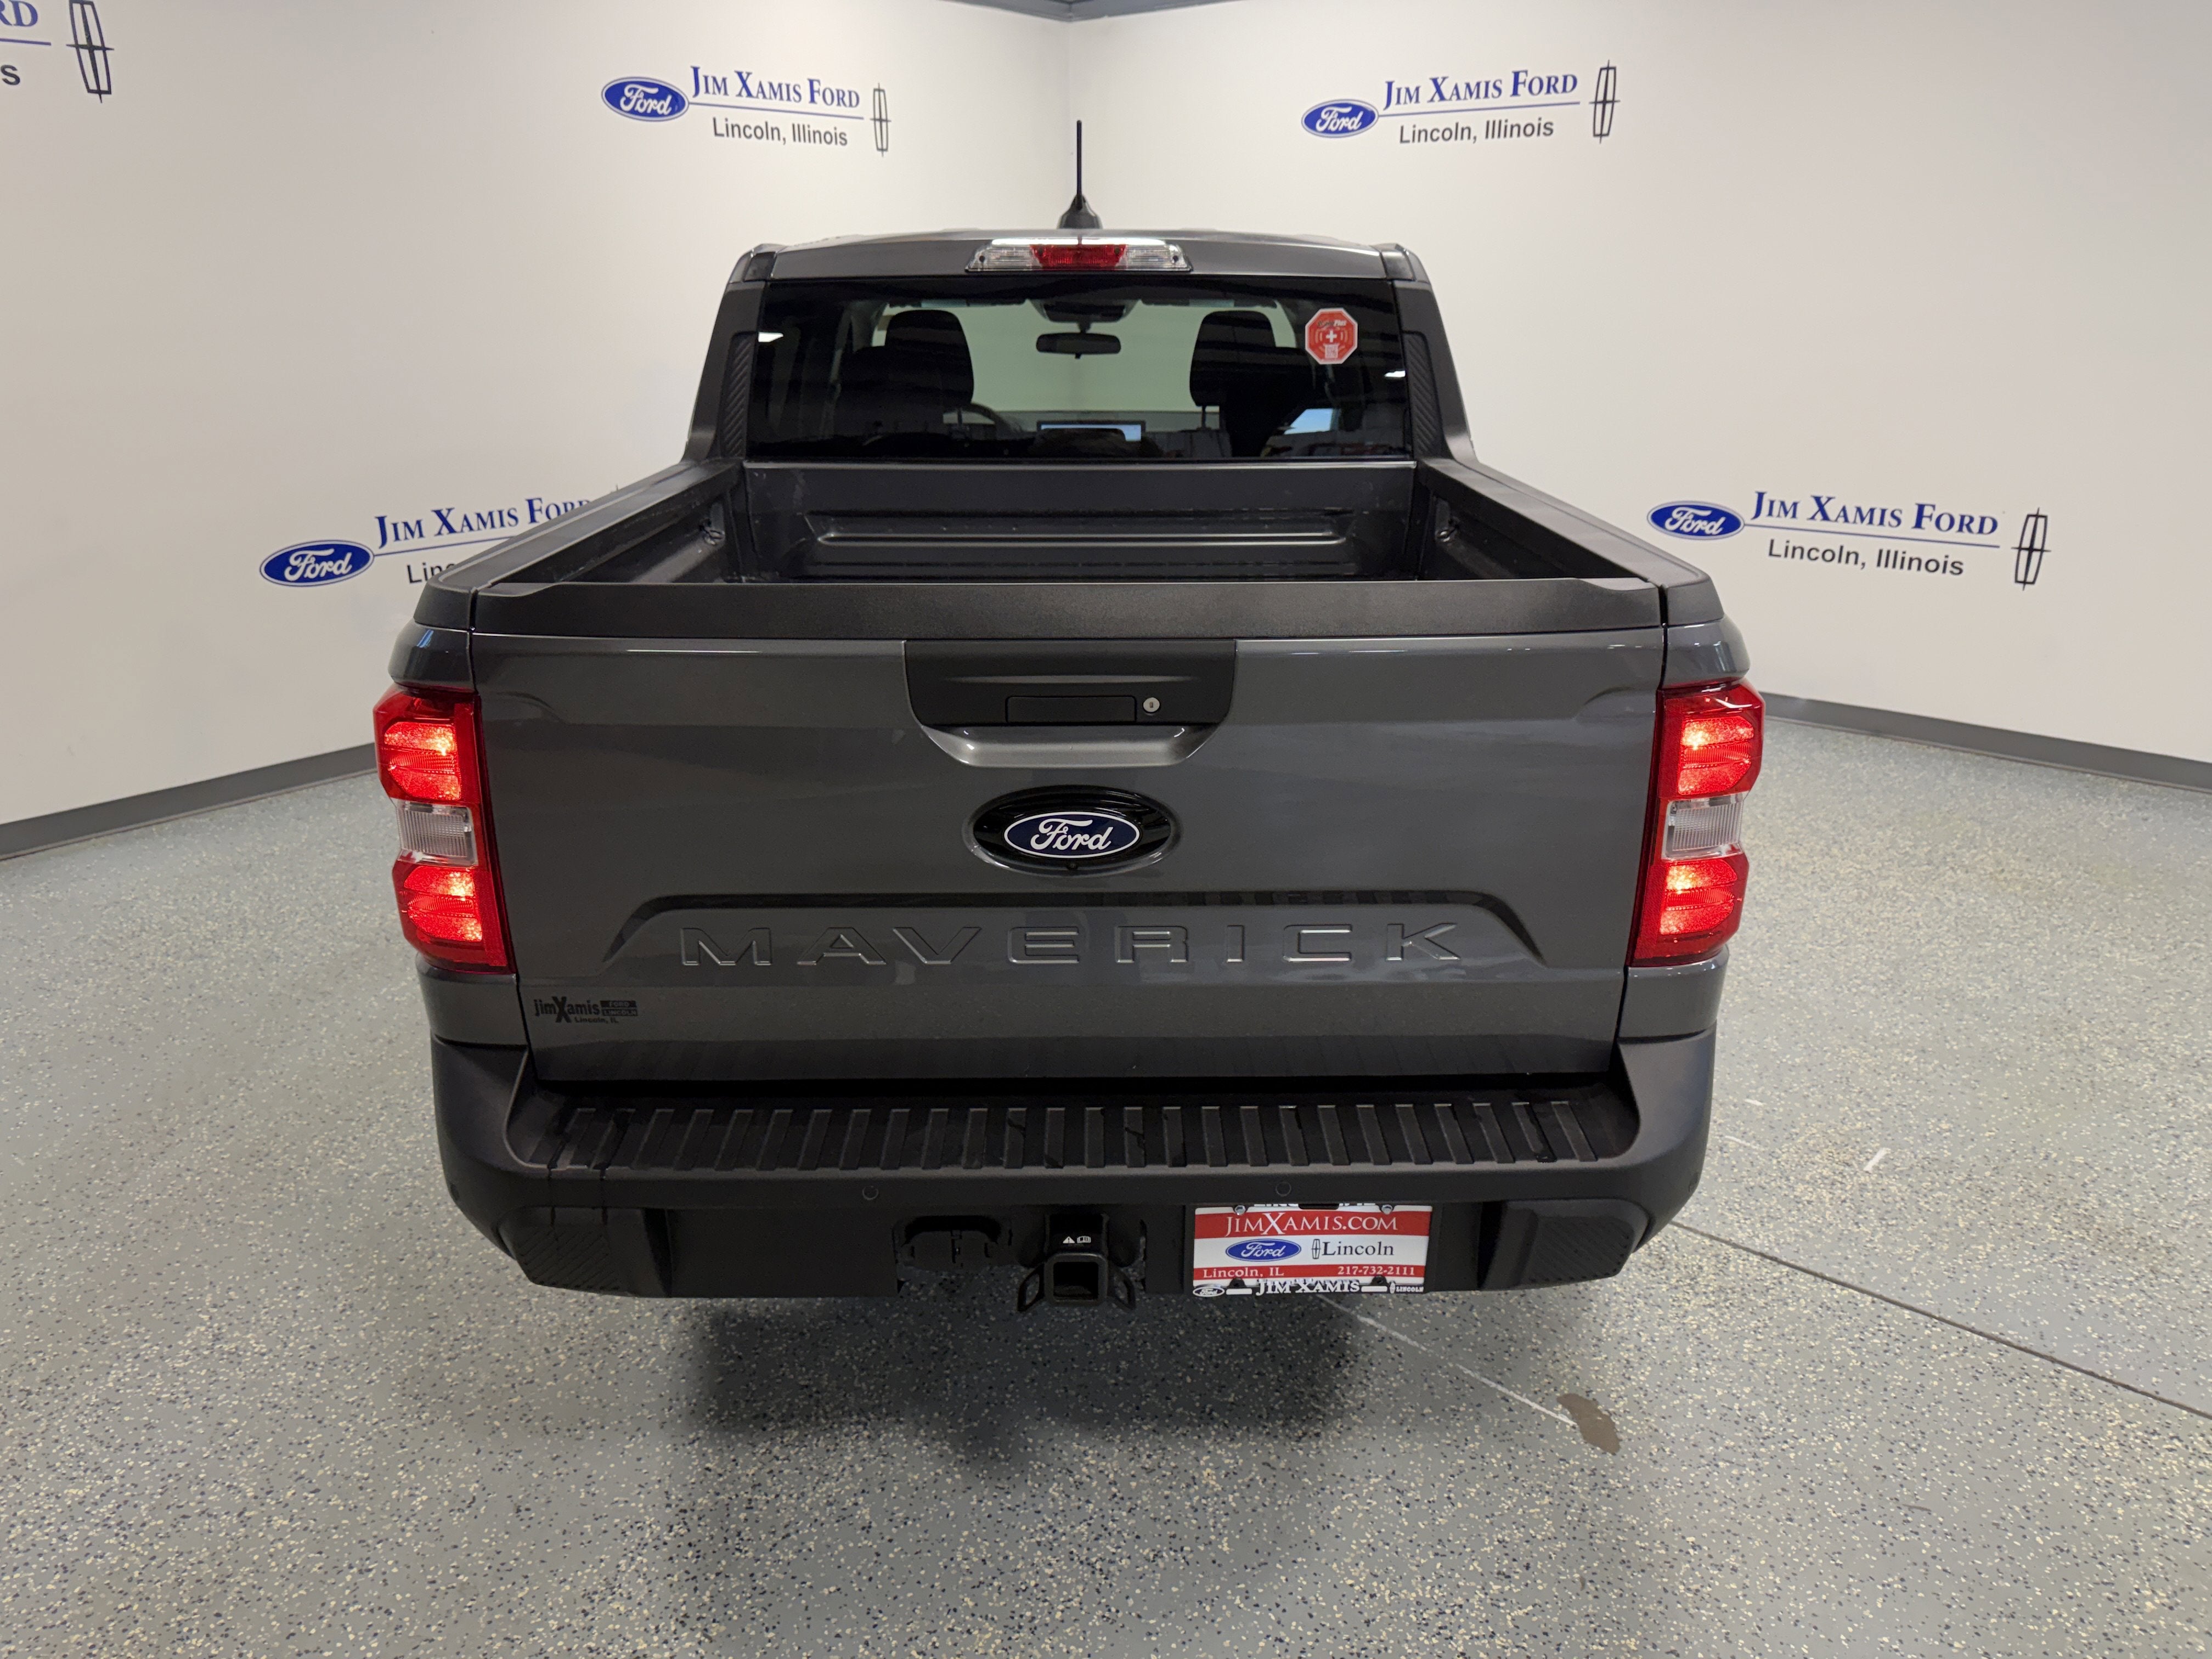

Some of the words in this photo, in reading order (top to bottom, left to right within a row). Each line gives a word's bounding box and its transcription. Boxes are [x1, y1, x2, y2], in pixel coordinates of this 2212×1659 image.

[620, 83, 672, 115] Ford
[690, 65, 729, 98] JIM
[735, 70, 802, 103] XAMIS
[807, 78, 860, 108] FORD
[1383, 80, 1421, 111] JIM
[1427, 76, 1503, 103] XAMIS
[1510, 70, 1578, 97] FORD
[713, 117, 787, 145] Lincoln,
[792, 123, 848, 146] Illinois
[1316, 106, 1363, 132] Ford
[1399, 122, 1478, 144] Lincoln,
[1485, 117, 1555, 140] Illinois
[374, 515, 425, 549] JIM
[431, 507, 520, 537] XAMIS
[1664, 506, 1725, 537] Ford
[1751, 491, 1800, 520] JIM
[1807, 495, 1903, 528] XAMIS
[1911, 503, 1999, 536] FORD
[284, 548, 353, 582] Ford
[1768, 539, 1866, 569] Lincoln,
[1876, 548, 1965, 576] Illinois
[1030, 818, 1114, 850] Ford
[680, 923, 1460, 967] MAVERICK
[1242, 1242, 1285, 1258] Ford
[1322, 1241, 1394, 1256] Lincoln
[1203, 1267, 1263, 1278] Lincoln,
[1269, 1267, 1284, 1276] IL
[1338, 1266, 1415, 1276] 217-732-2111
[1255, 1279, 1291, 1296] JIM
[1295, 1279, 1361, 1293] XAMIS
